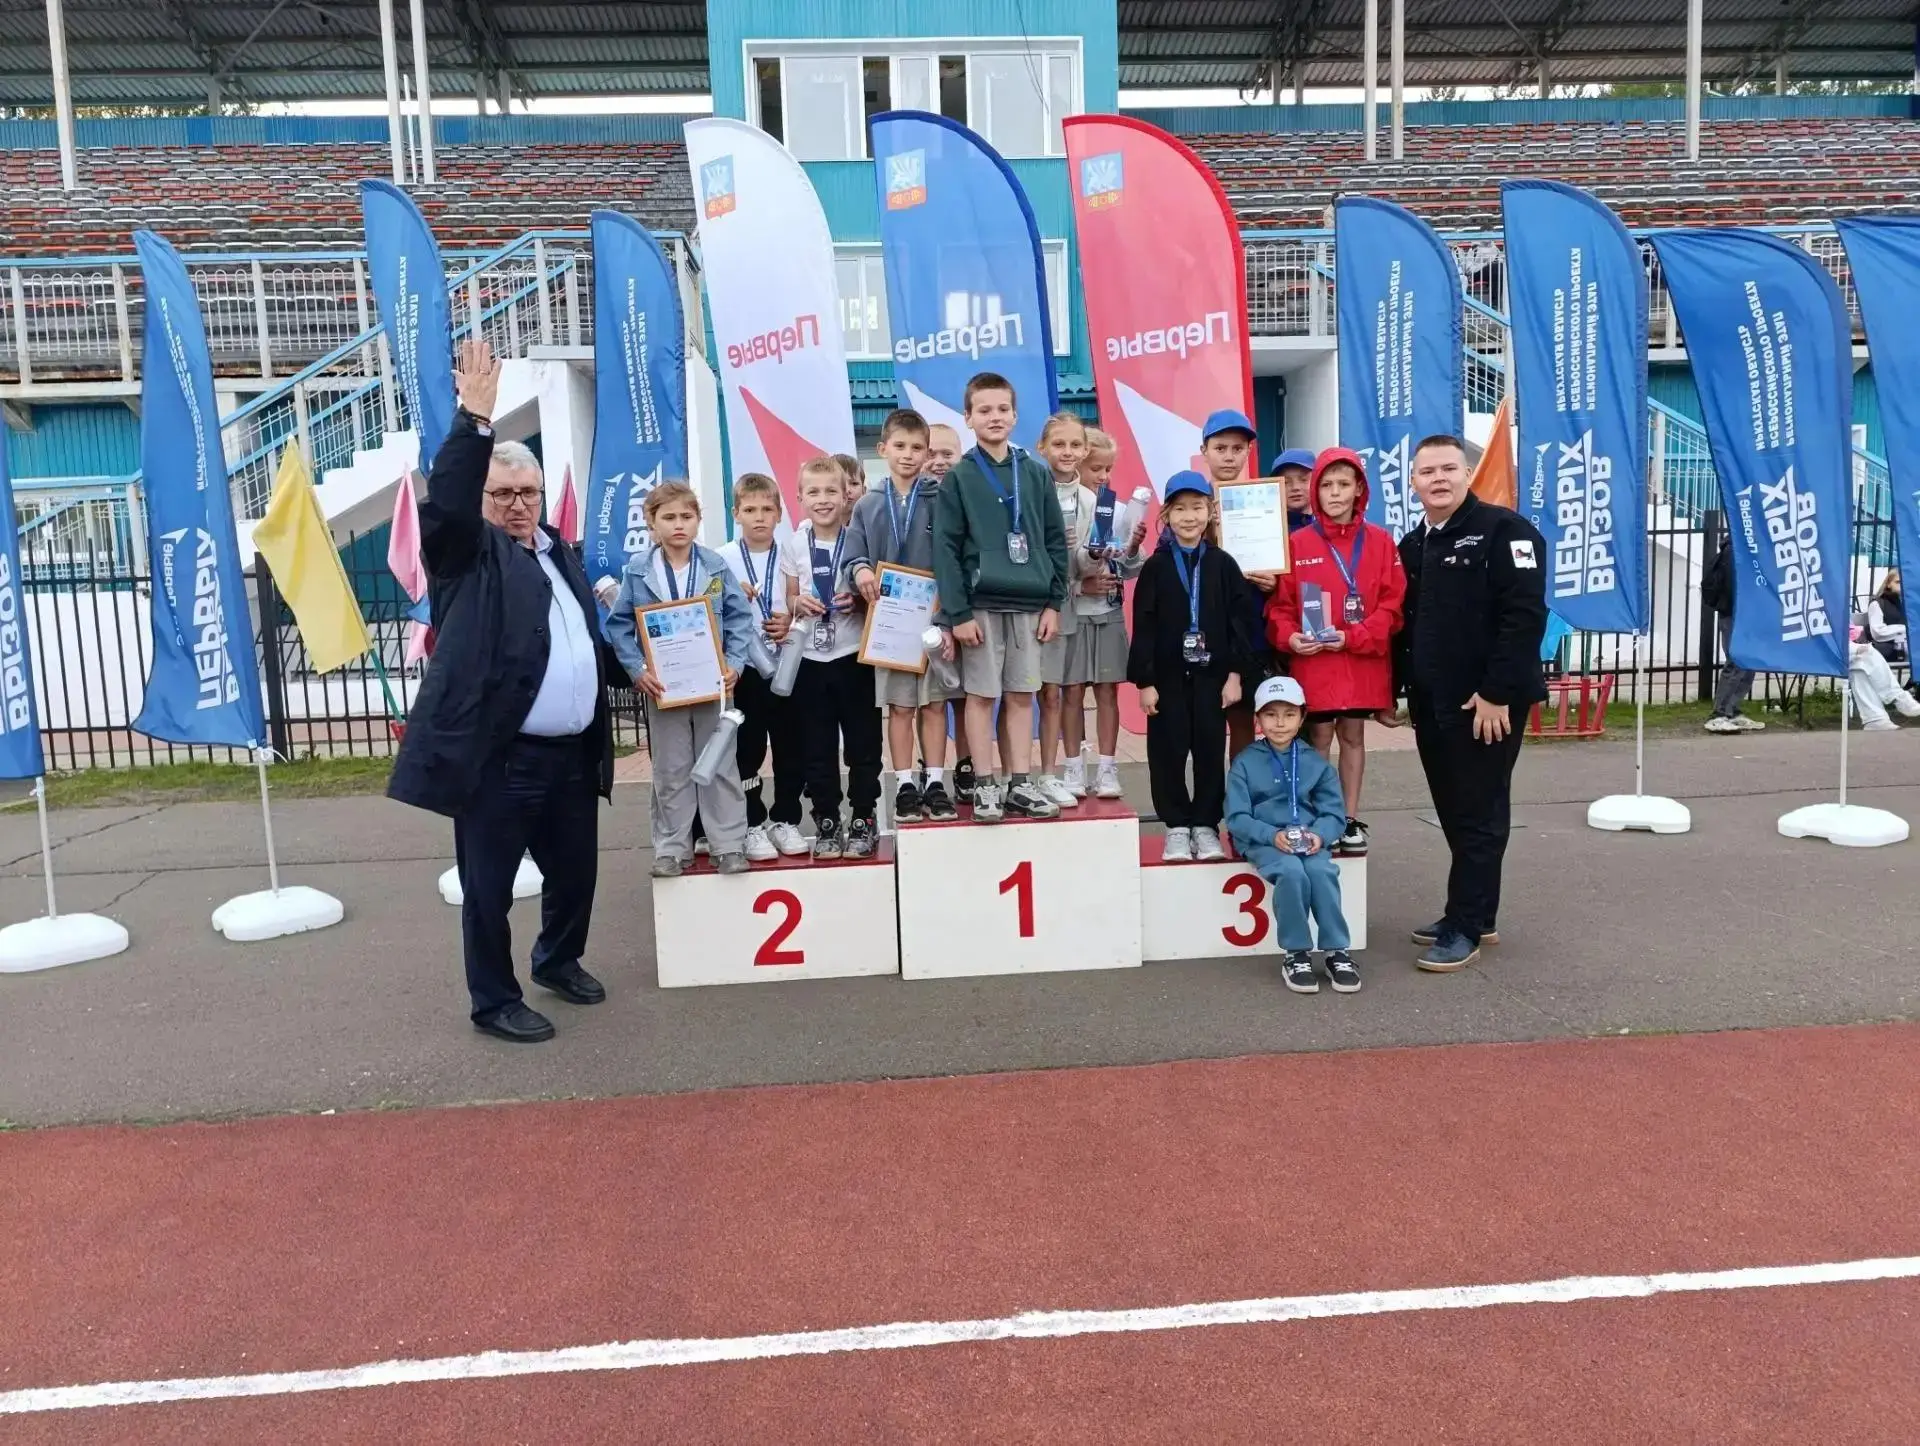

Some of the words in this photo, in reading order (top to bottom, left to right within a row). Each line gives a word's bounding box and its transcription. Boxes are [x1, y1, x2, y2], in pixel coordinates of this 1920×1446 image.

[751, 889, 806, 967] 2
[998, 861, 1035, 938] 1
[1221, 873, 1270, 948] 3
